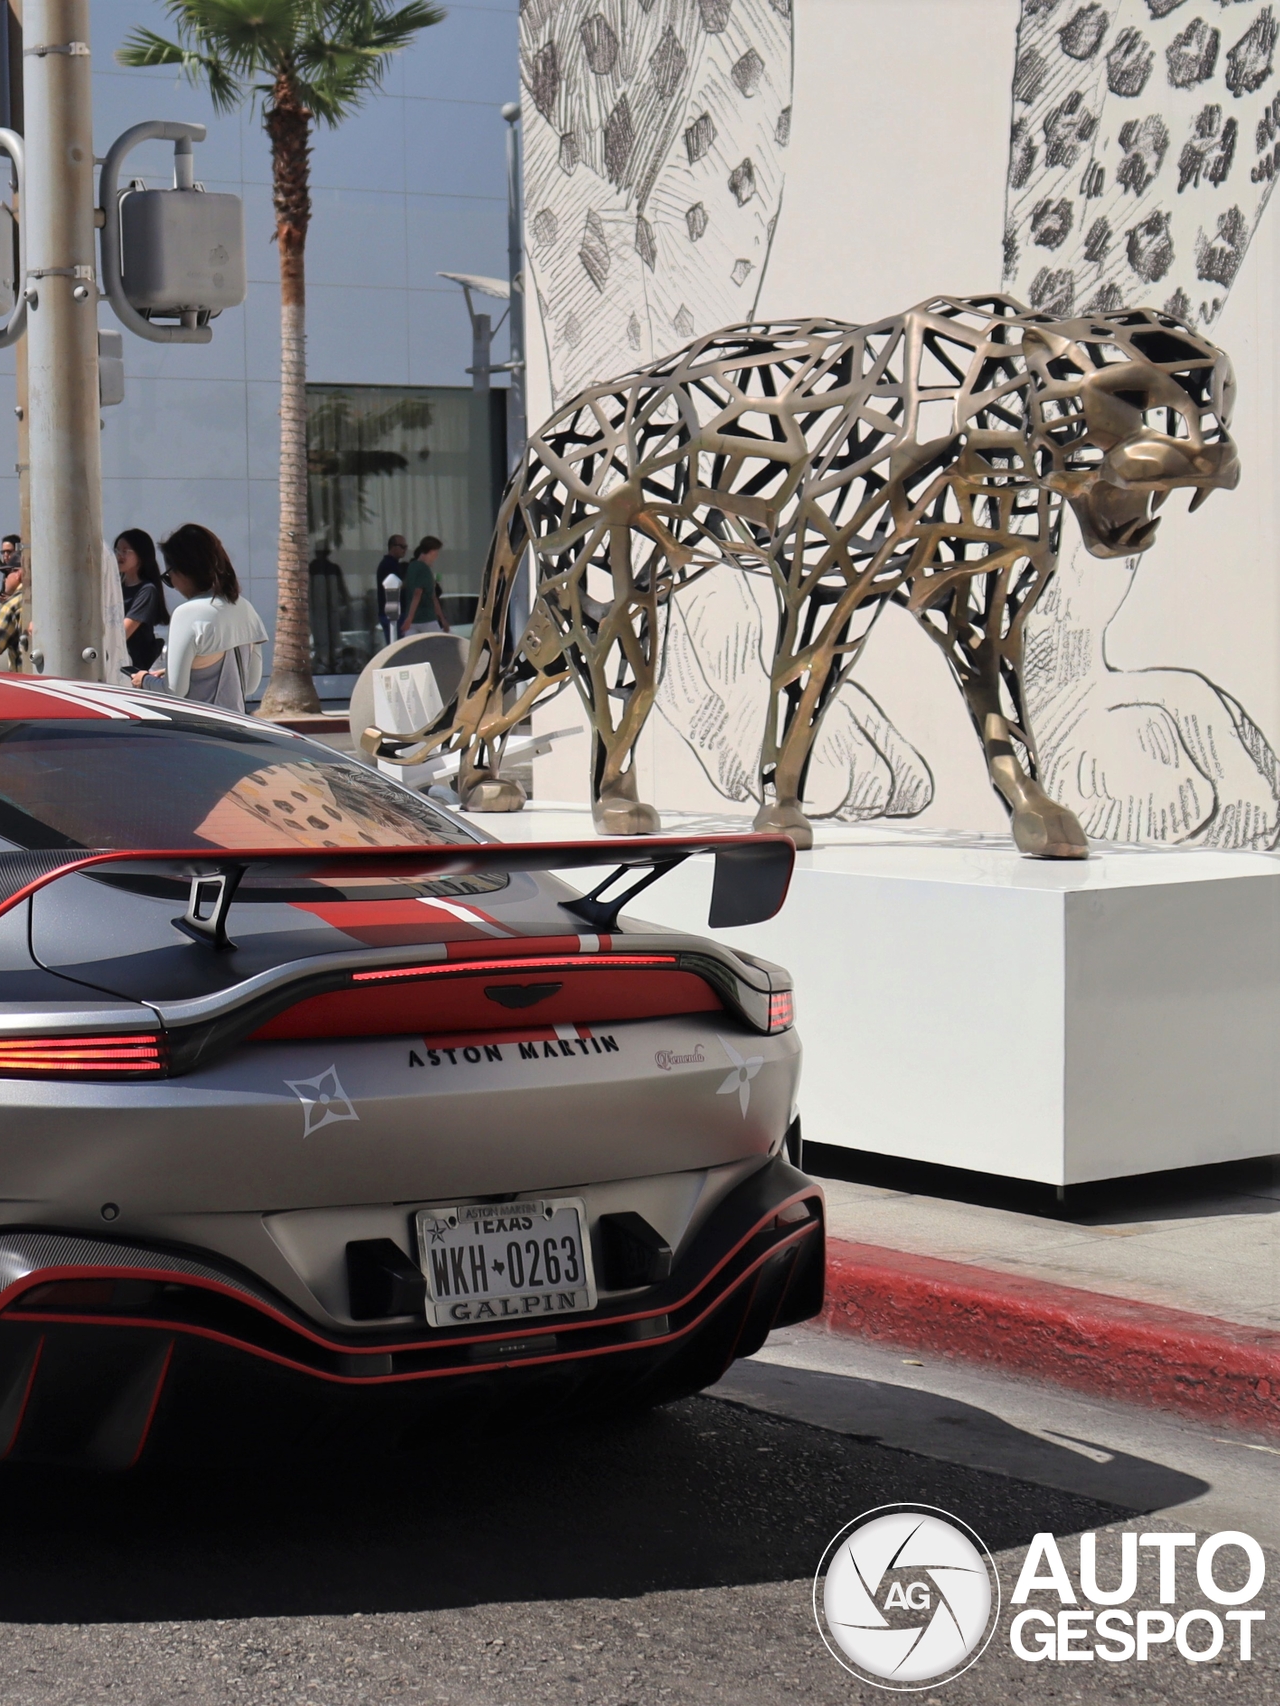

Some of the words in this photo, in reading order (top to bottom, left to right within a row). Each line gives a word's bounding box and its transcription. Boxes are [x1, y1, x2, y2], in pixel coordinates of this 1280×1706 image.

[408, 1044, 503, 1068] ASTON
[518, 1035, 620, 1060] MARTIN
[466, 1207, 498, 1219] ASTON
[500, 1203, 537, 1216] MARTIN
[474, 1217, 533, 1235] TEXAS
[431, 1245, 489, 1297] WKH
[506, 1236, 579, 1288] 0263
[450, 1292, 576, 1320] GALPIN
